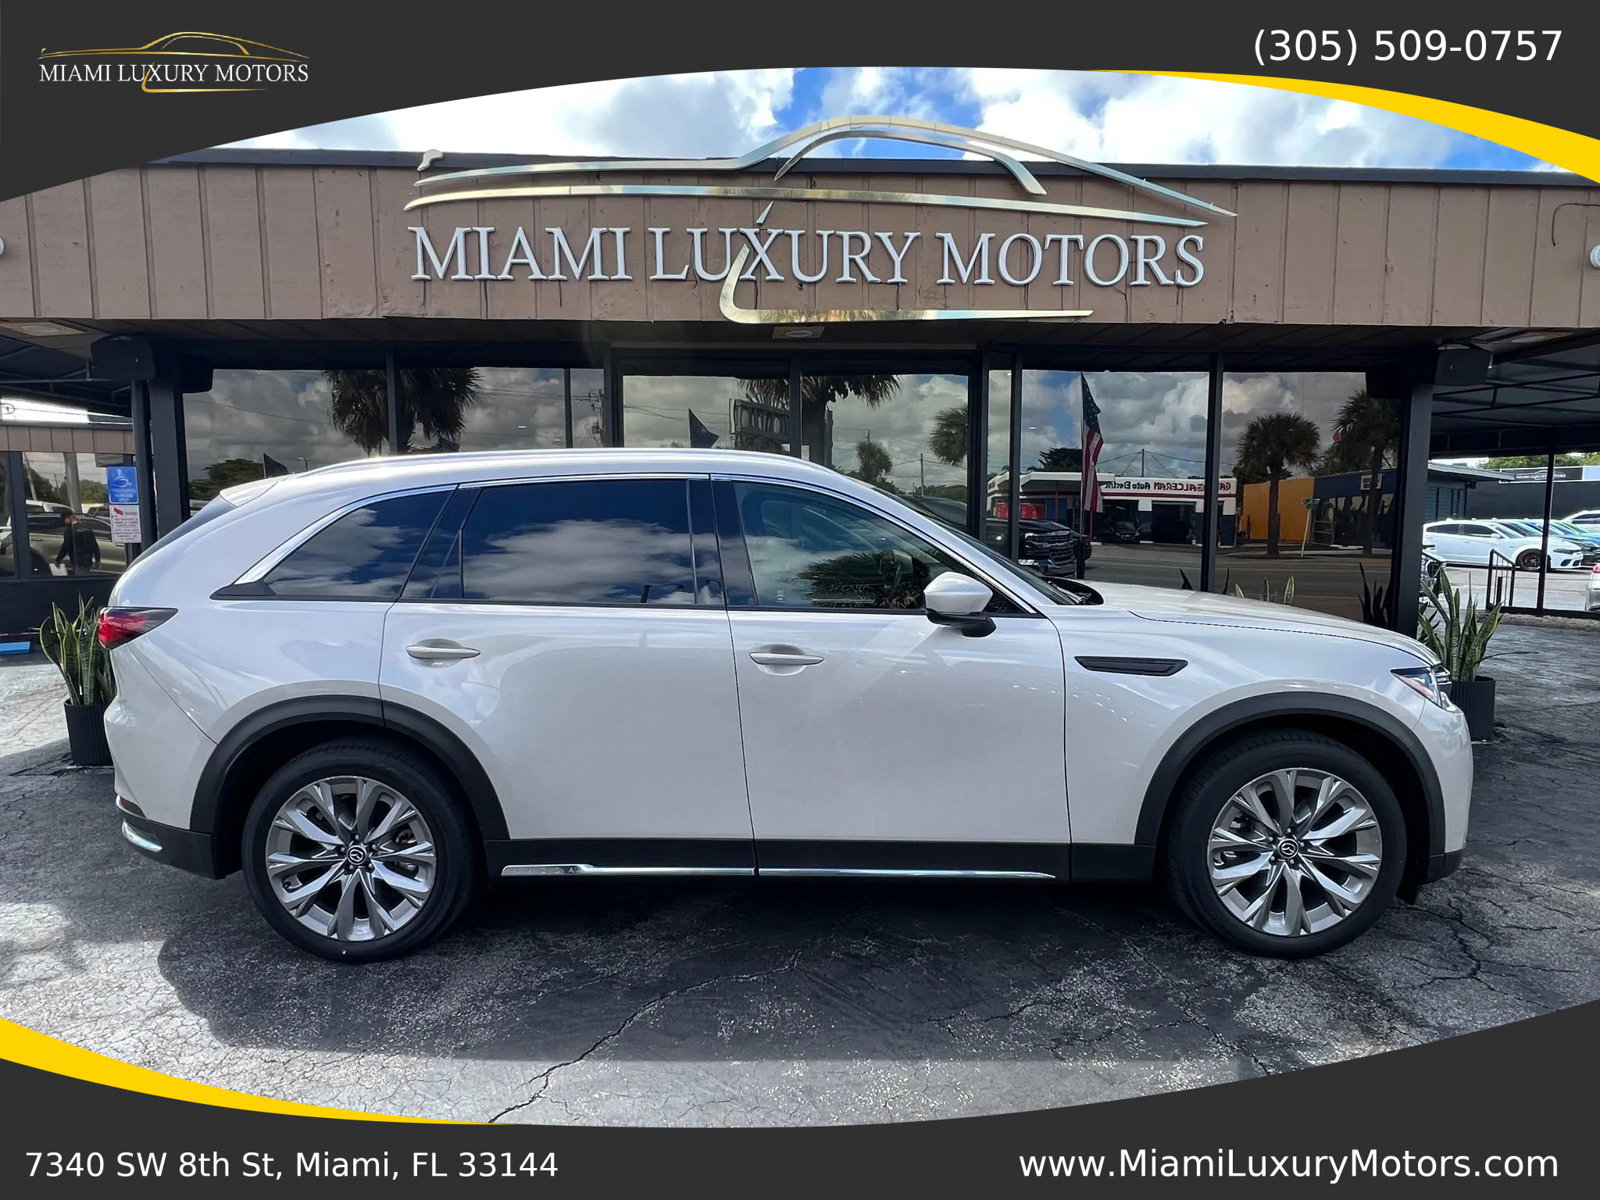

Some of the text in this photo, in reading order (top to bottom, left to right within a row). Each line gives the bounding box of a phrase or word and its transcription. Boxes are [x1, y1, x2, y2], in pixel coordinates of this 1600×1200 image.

[408, 226, 1205, 287] MIAMI LUXURY MOTORS
